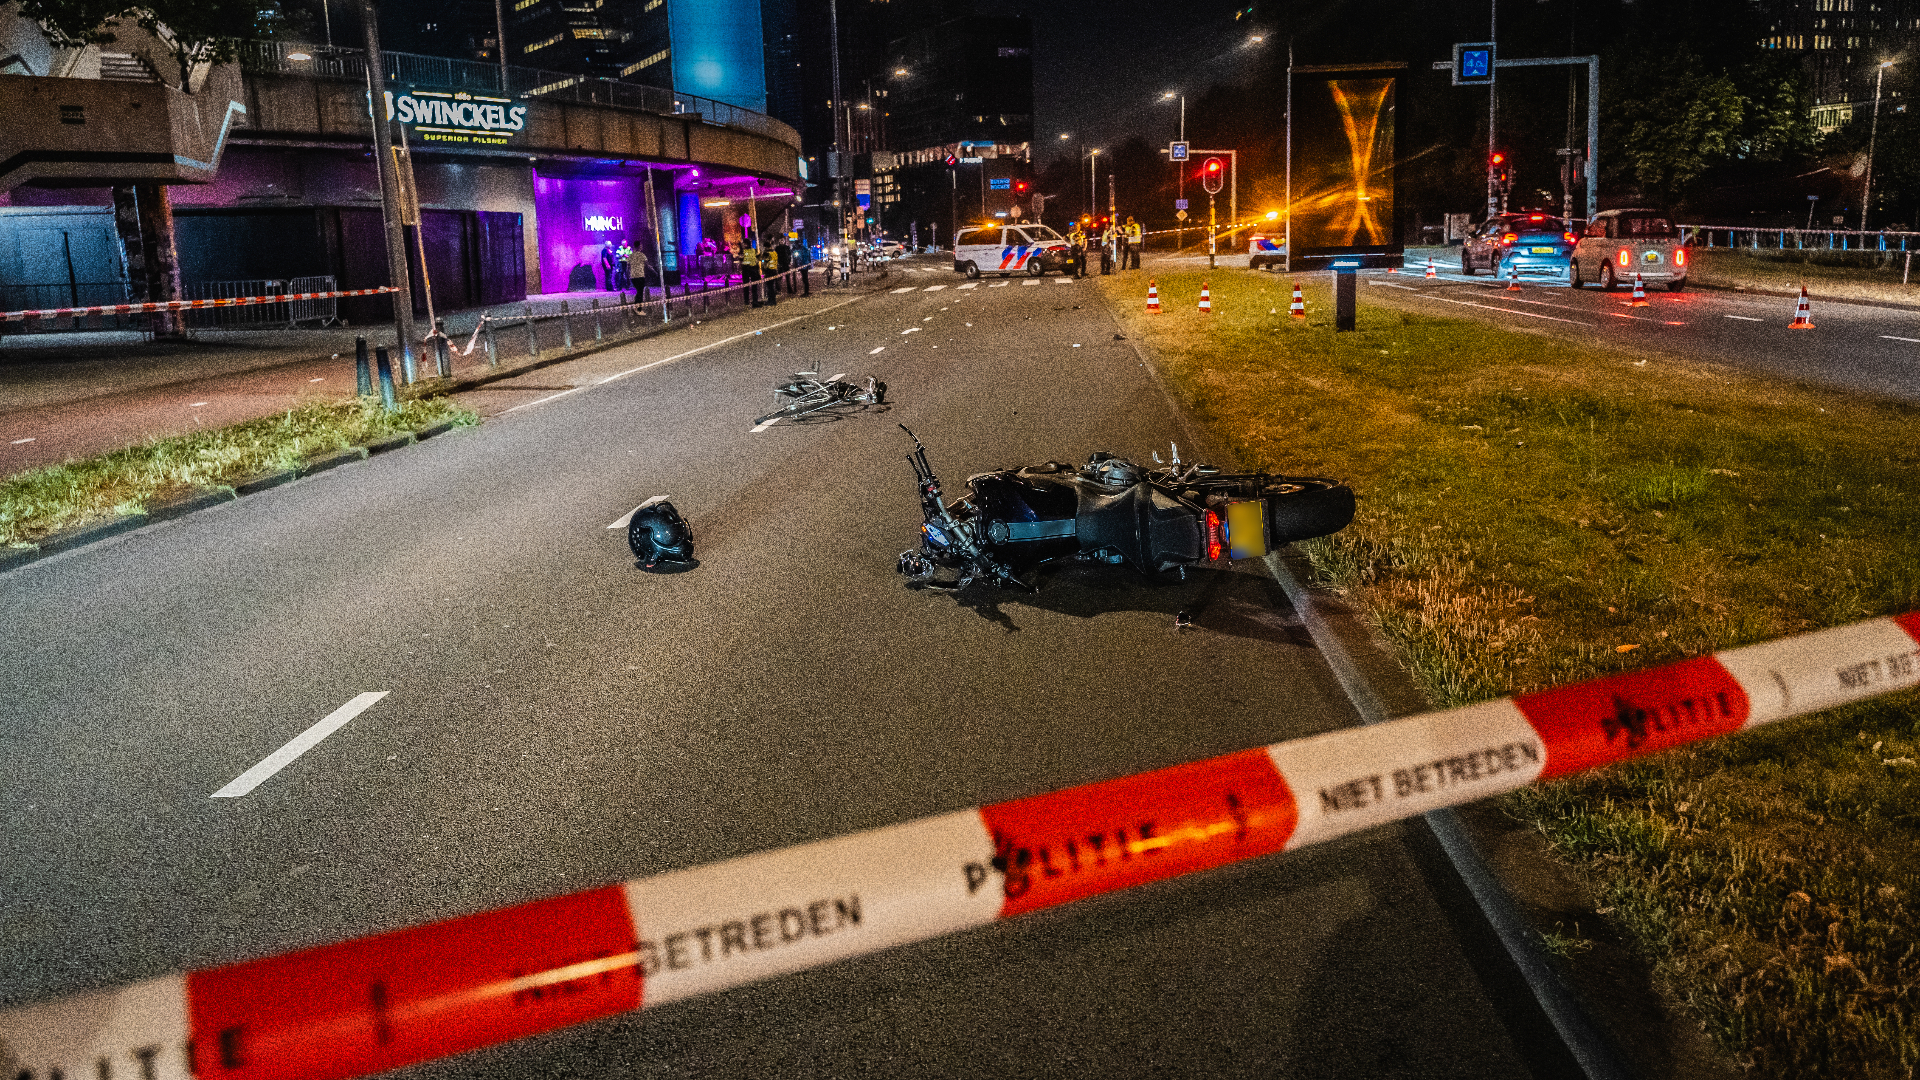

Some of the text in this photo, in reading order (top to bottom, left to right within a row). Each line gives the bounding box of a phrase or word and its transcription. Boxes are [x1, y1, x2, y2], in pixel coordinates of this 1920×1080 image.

[423, 133, 508, 145] SUPERIOR PILSNER
[1318, 742, 1540, 815] NIET BETREDEN
[635, 893, 864, 978] BETREDEN
